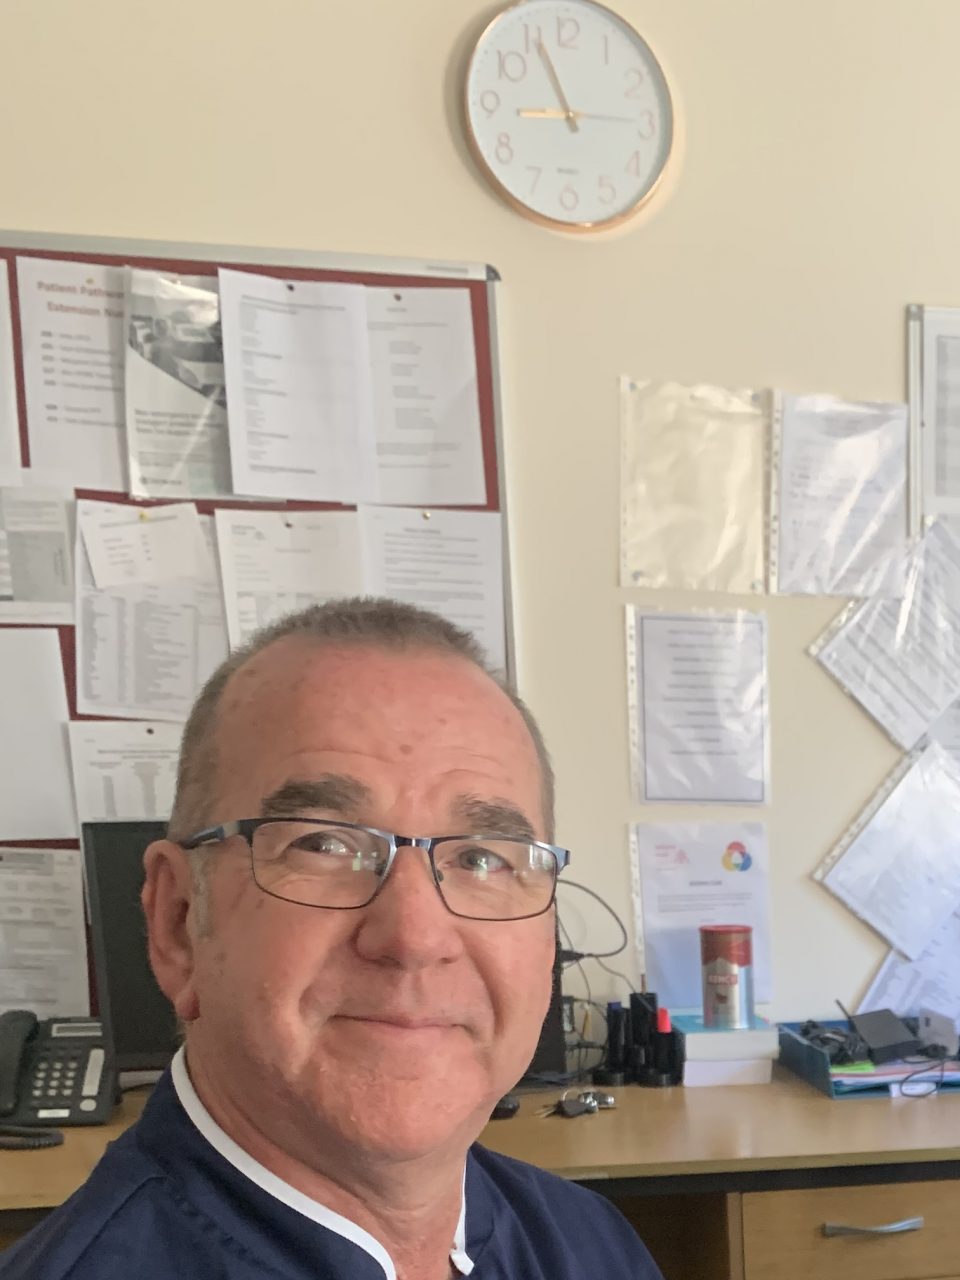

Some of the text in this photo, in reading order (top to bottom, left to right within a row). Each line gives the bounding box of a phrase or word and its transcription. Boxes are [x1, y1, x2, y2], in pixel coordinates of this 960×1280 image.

[556, 16, 581, 49] 12
[497, 49, 527, 83] 10
[624, 67, 643, 98] 2
[480, 90, 500, 119] 9
[637, 110, 655, 141] 3
[495, 132, 513, 165] 8
[625, 149, 641, 178] 4
[525, 165, 542, 195] 7
[598, 175, 616, 204] 5
[559, 184, 579, 211] 6
